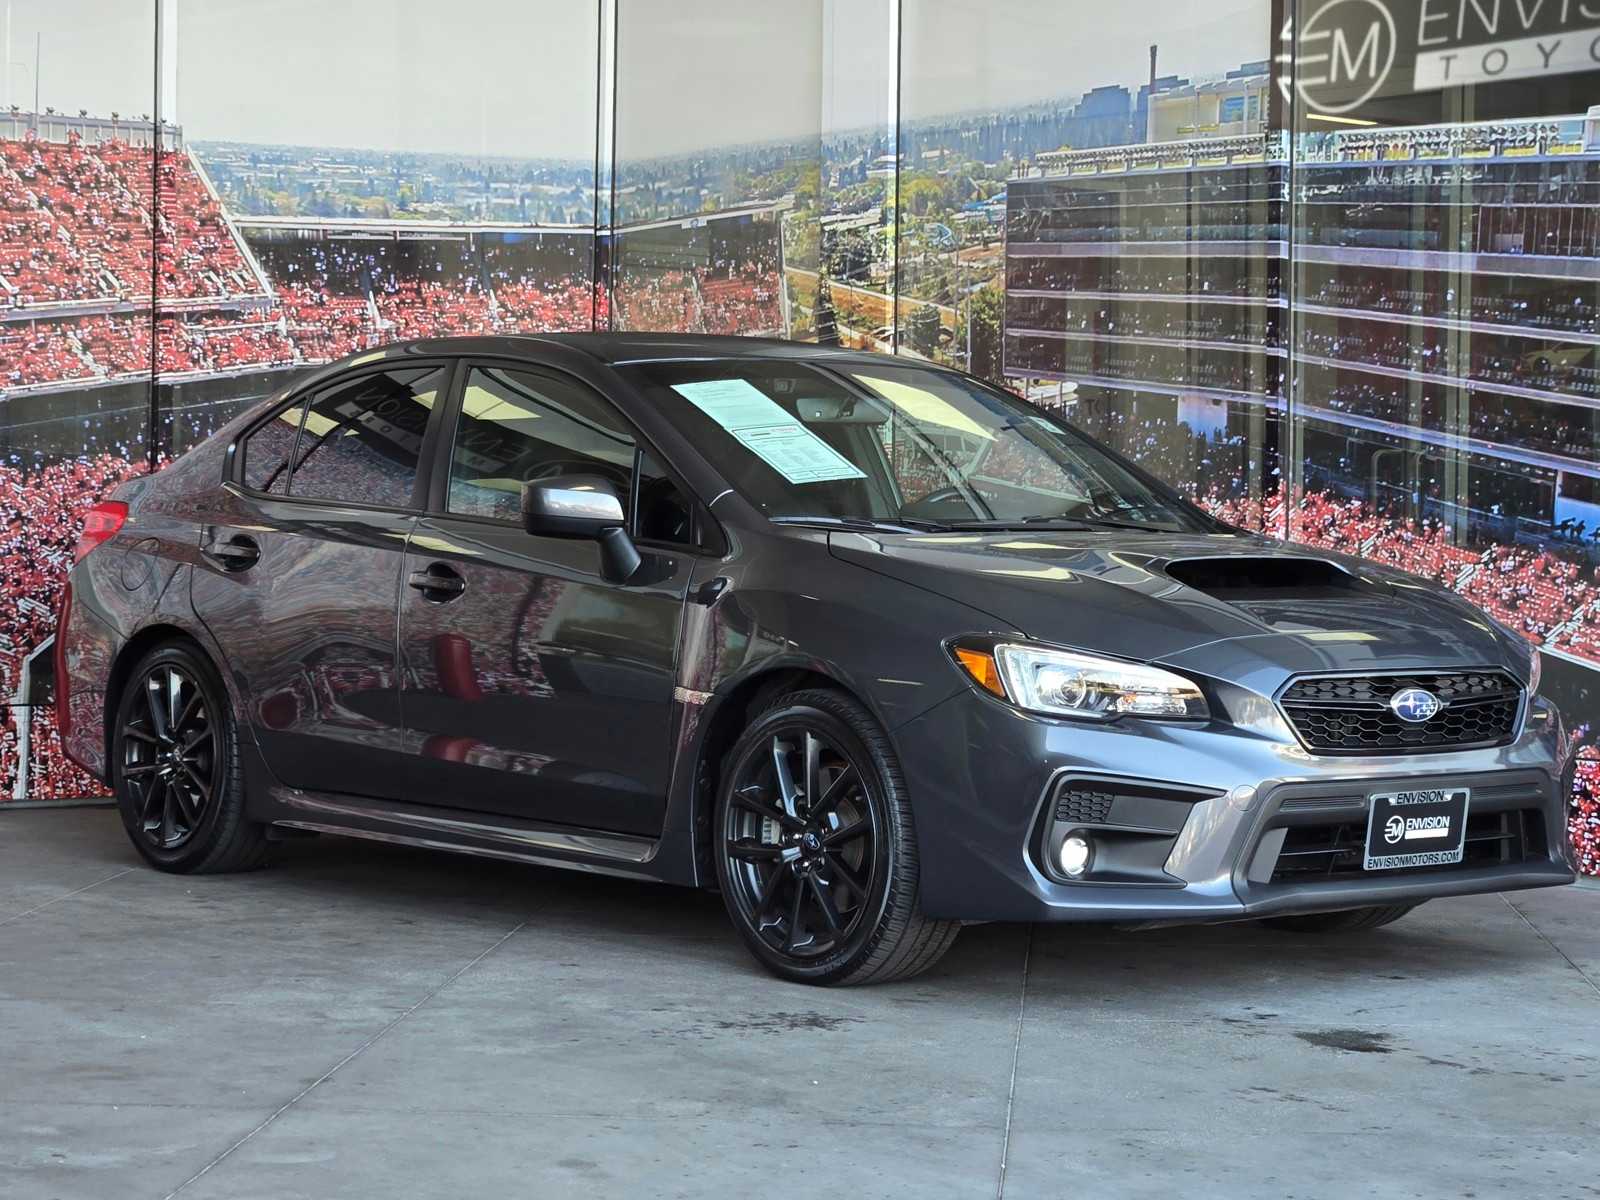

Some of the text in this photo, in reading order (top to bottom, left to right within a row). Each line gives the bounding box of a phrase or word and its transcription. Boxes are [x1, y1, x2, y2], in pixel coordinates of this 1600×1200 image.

[1418, 0, 1600, 46] ENV
[1396, 790, 1445, 804] ENVISION
[1406, 816, 1450, 830] ENVISION
[1367, 852, 1459, 869] ENVISIONMOTORS.COM
